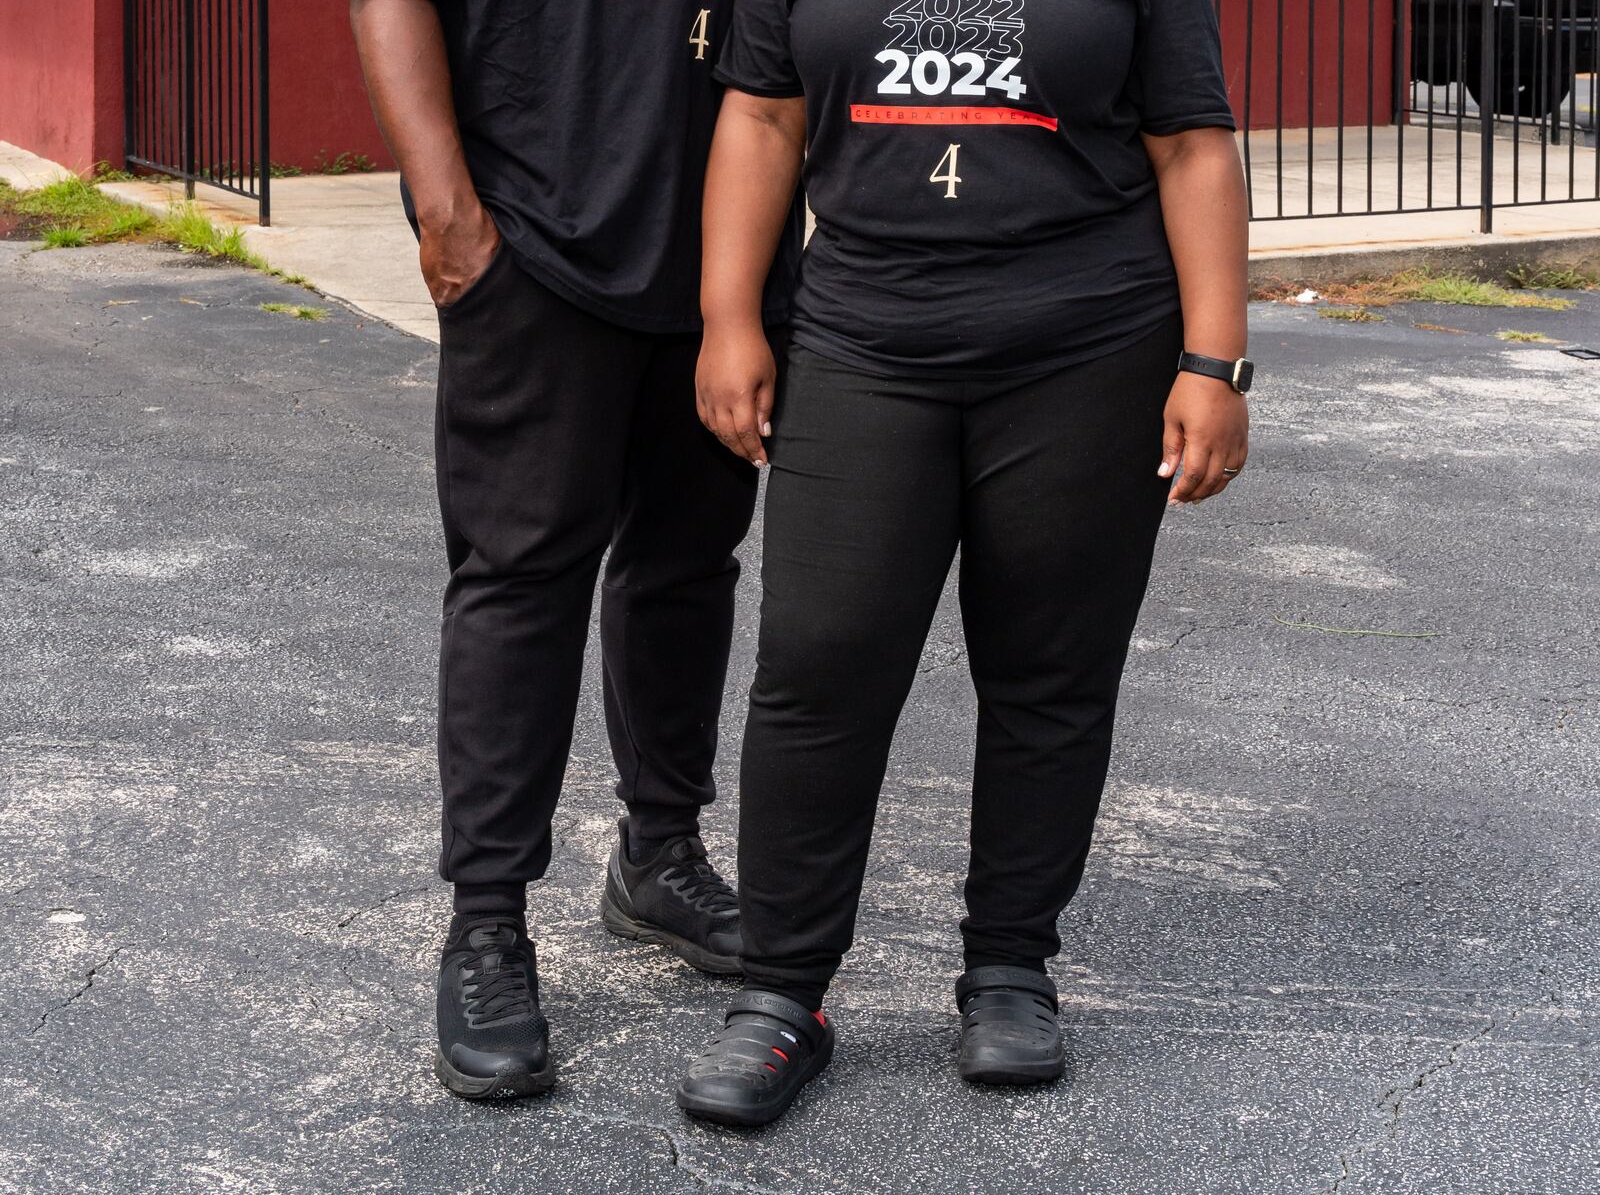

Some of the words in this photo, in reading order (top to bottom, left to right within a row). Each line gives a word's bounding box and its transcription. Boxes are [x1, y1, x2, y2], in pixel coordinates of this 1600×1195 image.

[689, 8, 711, 60] 4
[882, 15, 1025, 63] 2023
[874, 49, 1027, 100] 2024
[855, 109, 983, 120] CELEBRATING
[929, 144, 962, 198] 4
